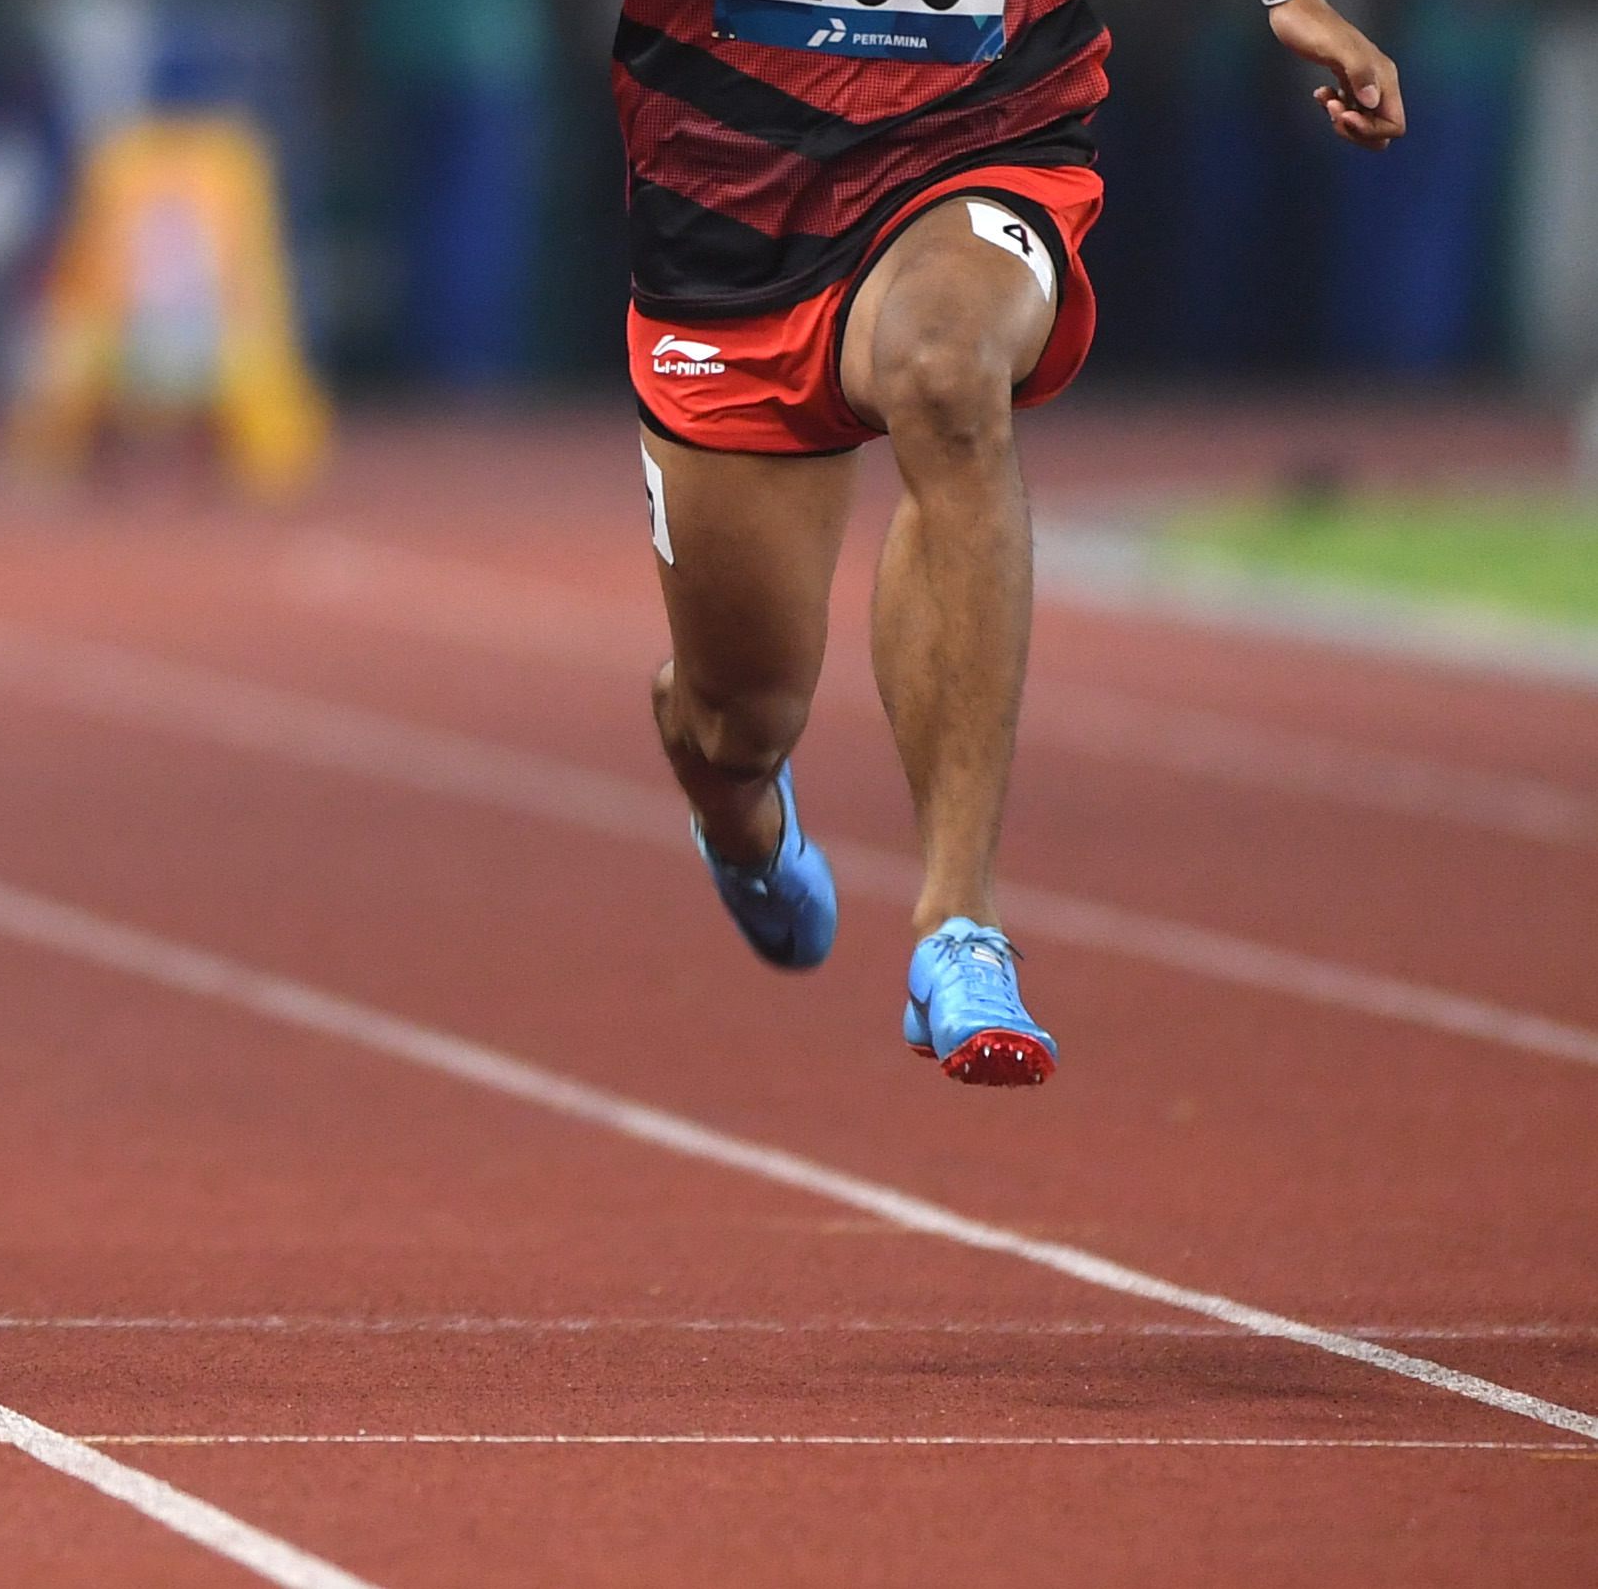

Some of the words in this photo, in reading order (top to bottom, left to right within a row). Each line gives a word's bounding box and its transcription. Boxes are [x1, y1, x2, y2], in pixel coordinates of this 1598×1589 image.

[852, 33, 928, 49] PERTAMINA
[1002, 223, 1034, 258] 4
[653, 358, 726, 376] LI-NING
